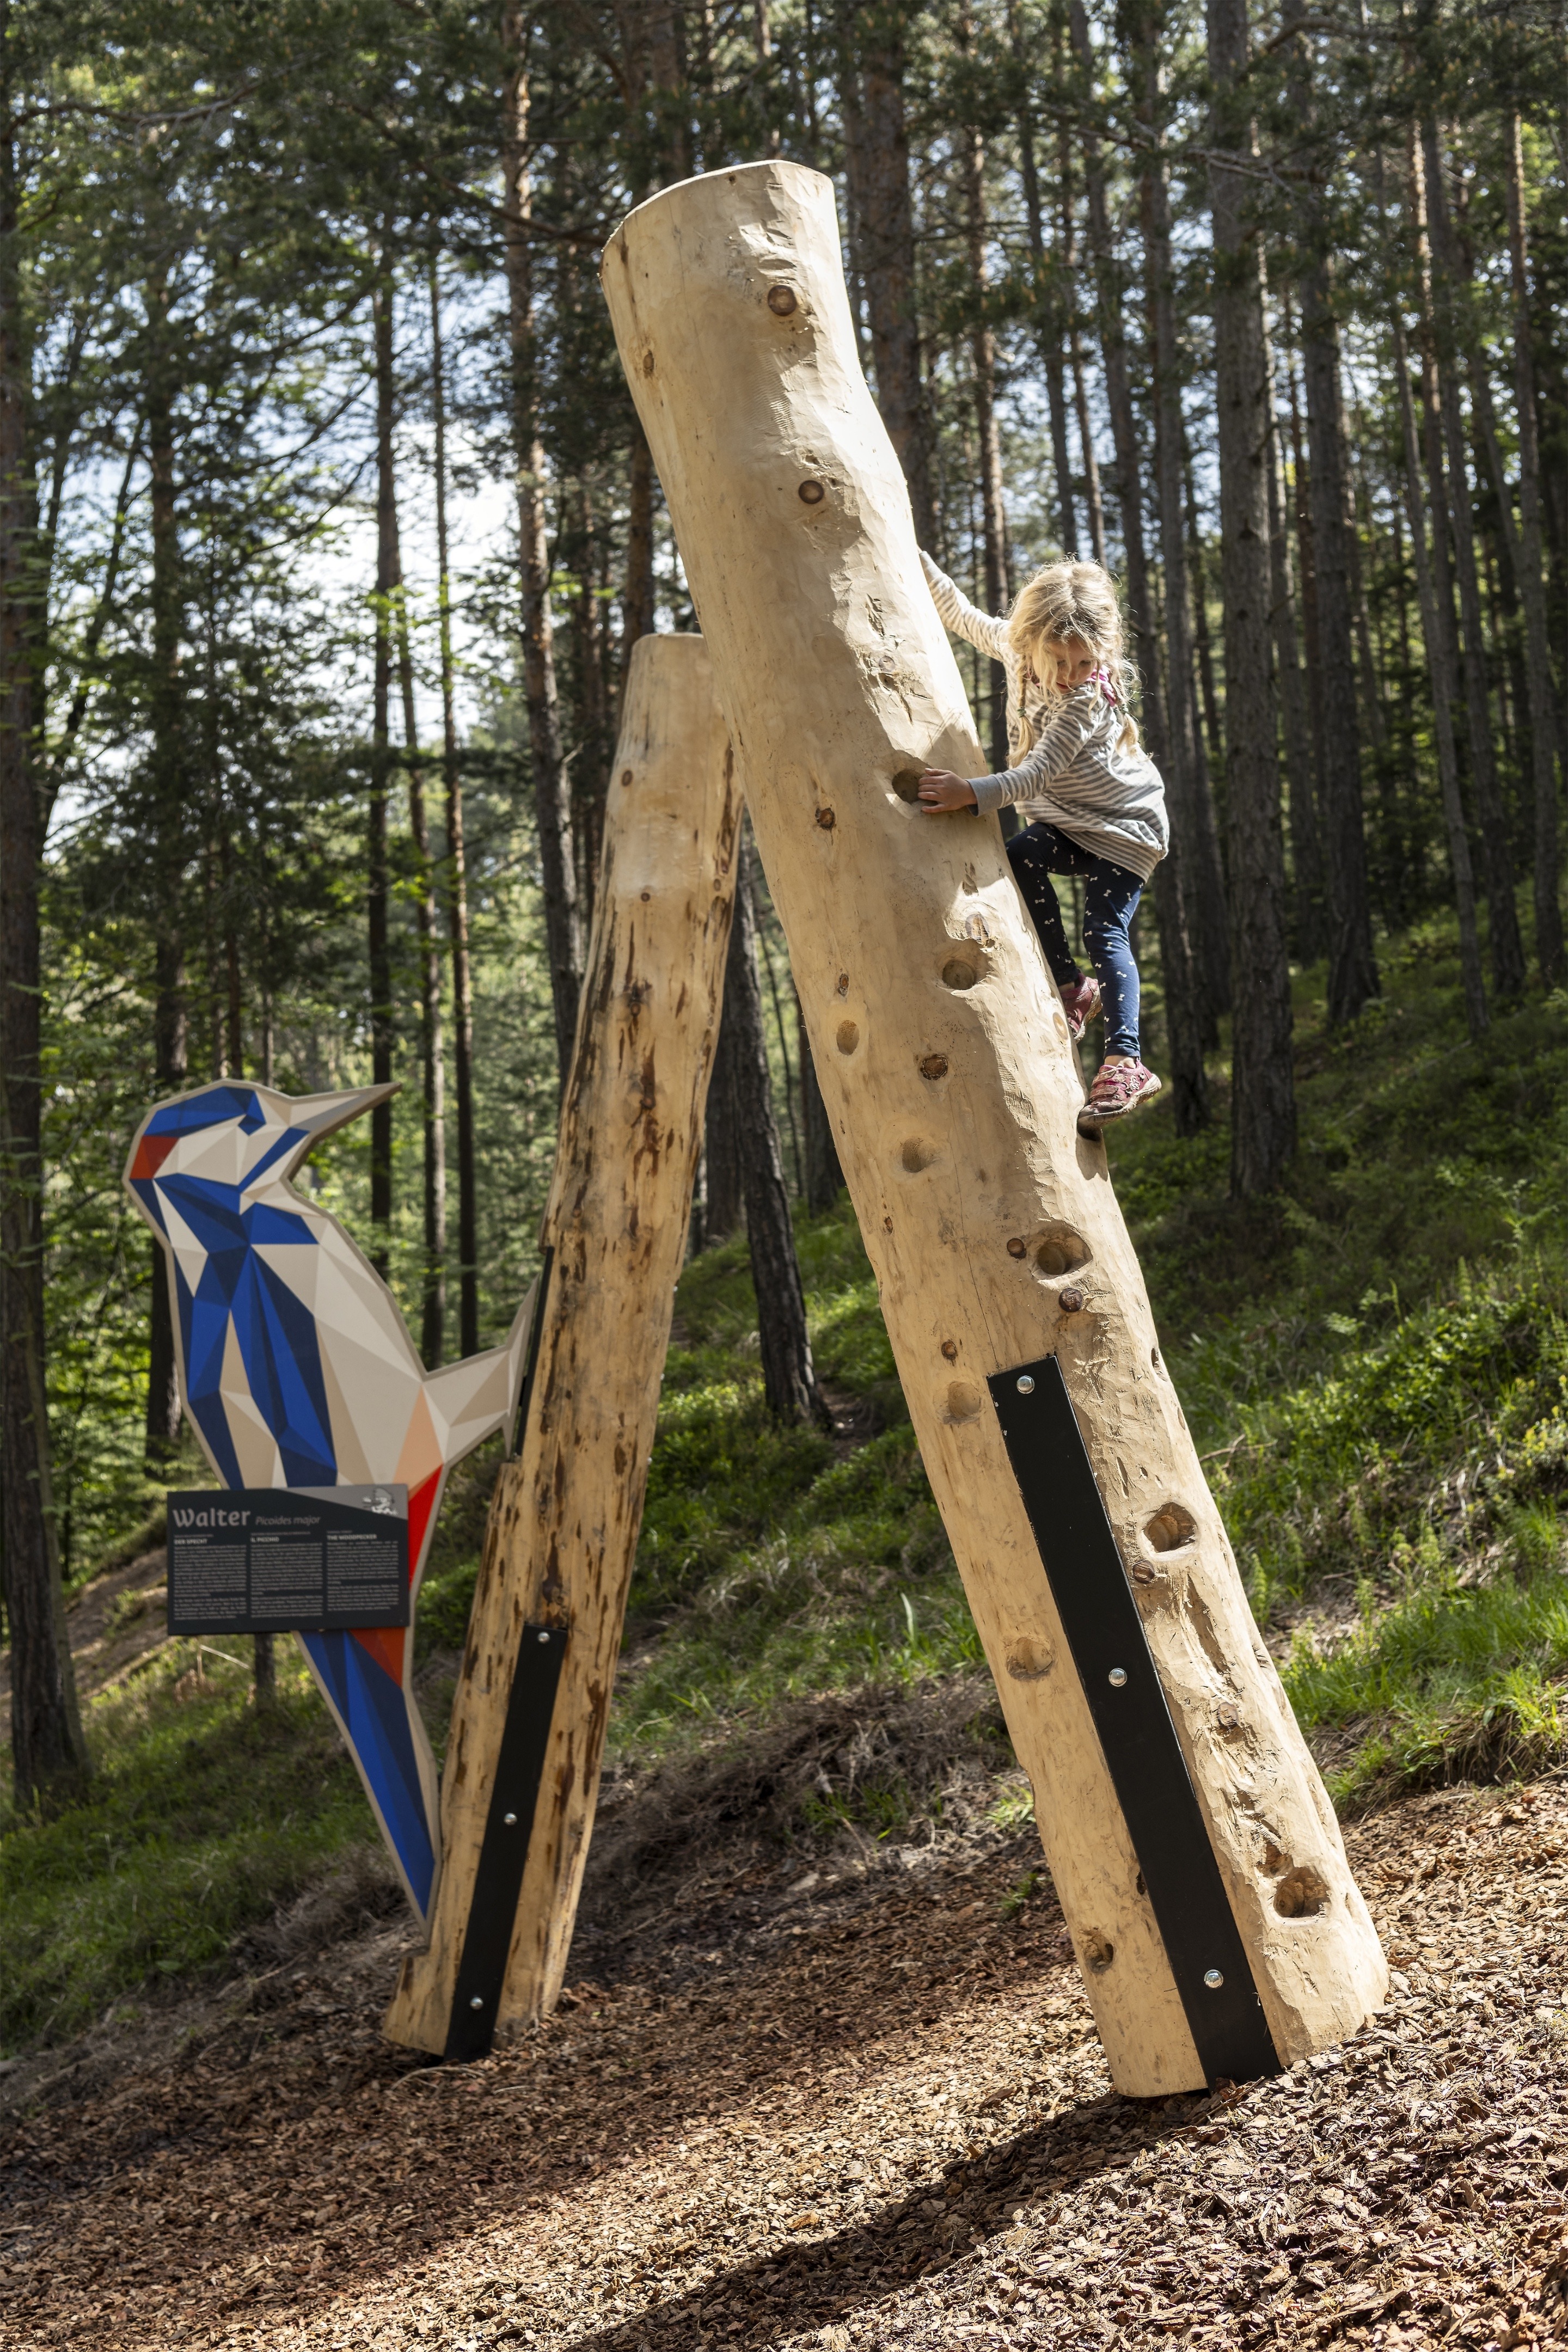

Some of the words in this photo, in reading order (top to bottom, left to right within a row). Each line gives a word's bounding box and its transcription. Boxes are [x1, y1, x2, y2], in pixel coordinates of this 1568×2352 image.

[172, 1508, 250, 1528] Walter
[255, 1515, 292, 1526] Picoides
[293, 1515, 321, 1527] major
